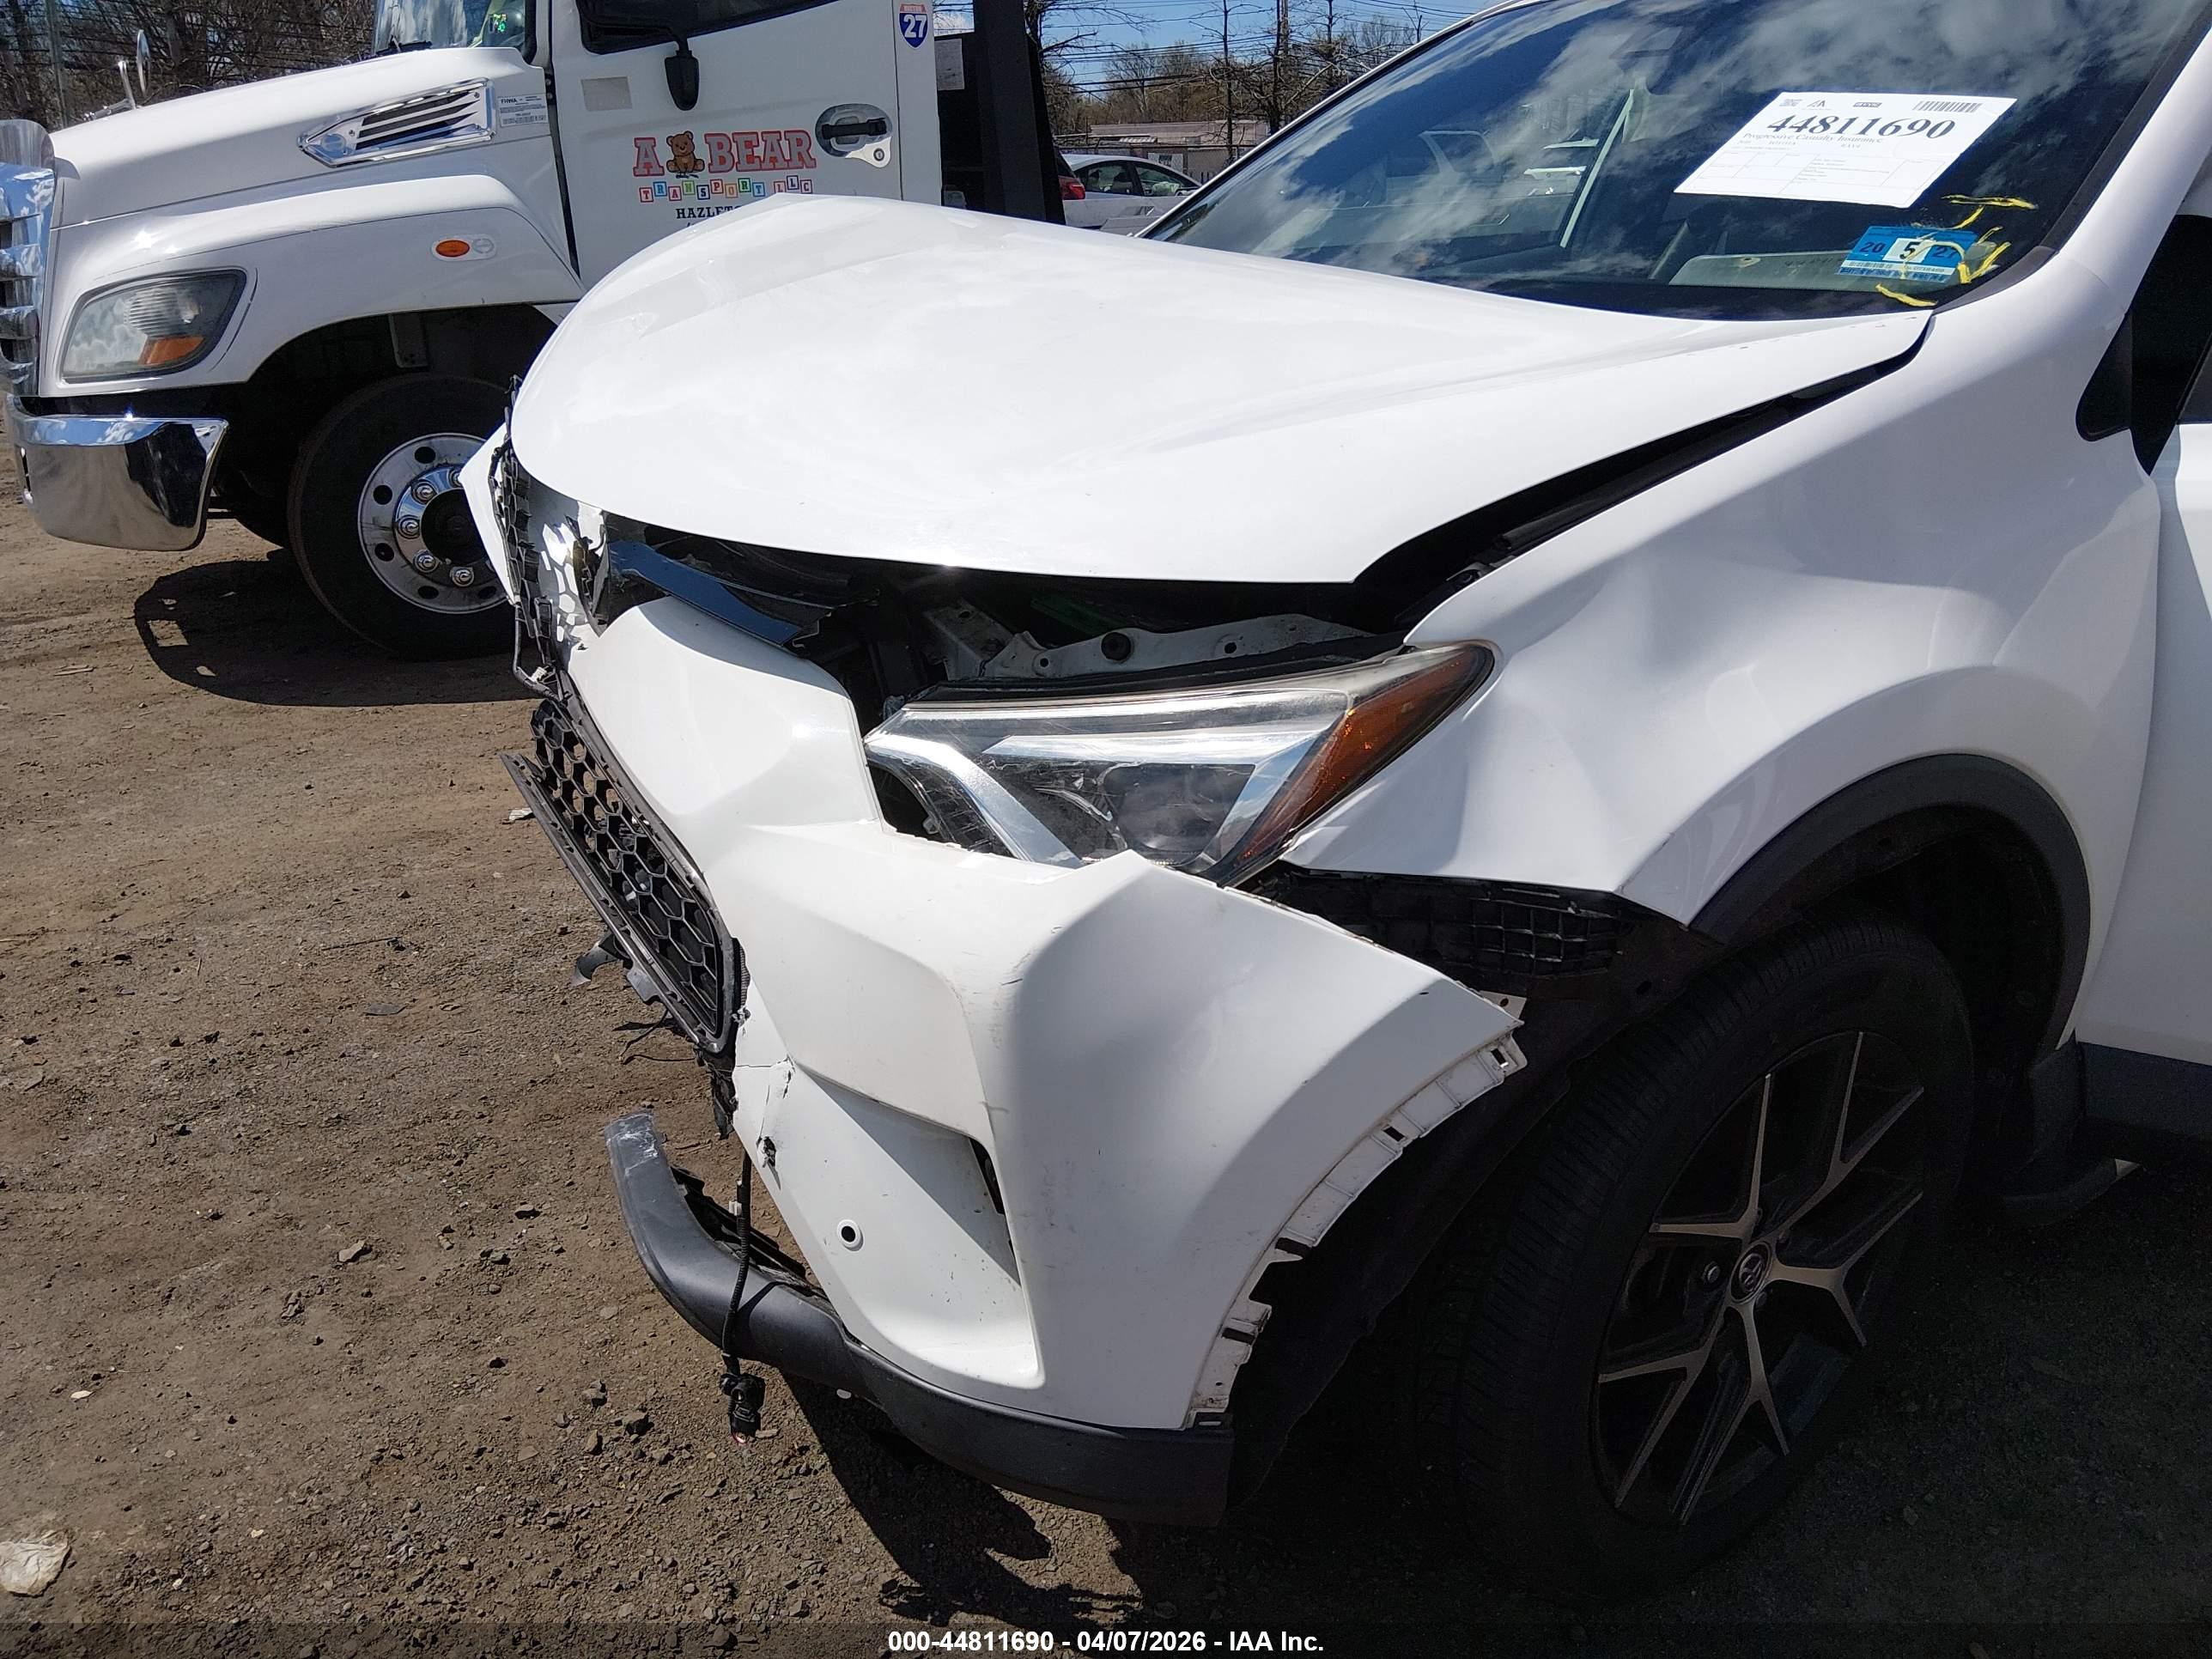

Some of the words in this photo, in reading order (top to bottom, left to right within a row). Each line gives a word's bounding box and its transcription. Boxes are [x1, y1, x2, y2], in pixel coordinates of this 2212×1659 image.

[902, 14, 927, 39] 27
[1767, 113, 1956, 140] 44811690
[633, 137, 665, 177] A
[704, 130, 817, 173] BEAR
[638, 177, 765, 203] TRANSPORT
[774, 175, 813, 194] LLC
[1859, 241, 1886, 253] 20
[1899, 241, 1922, 259] 5
